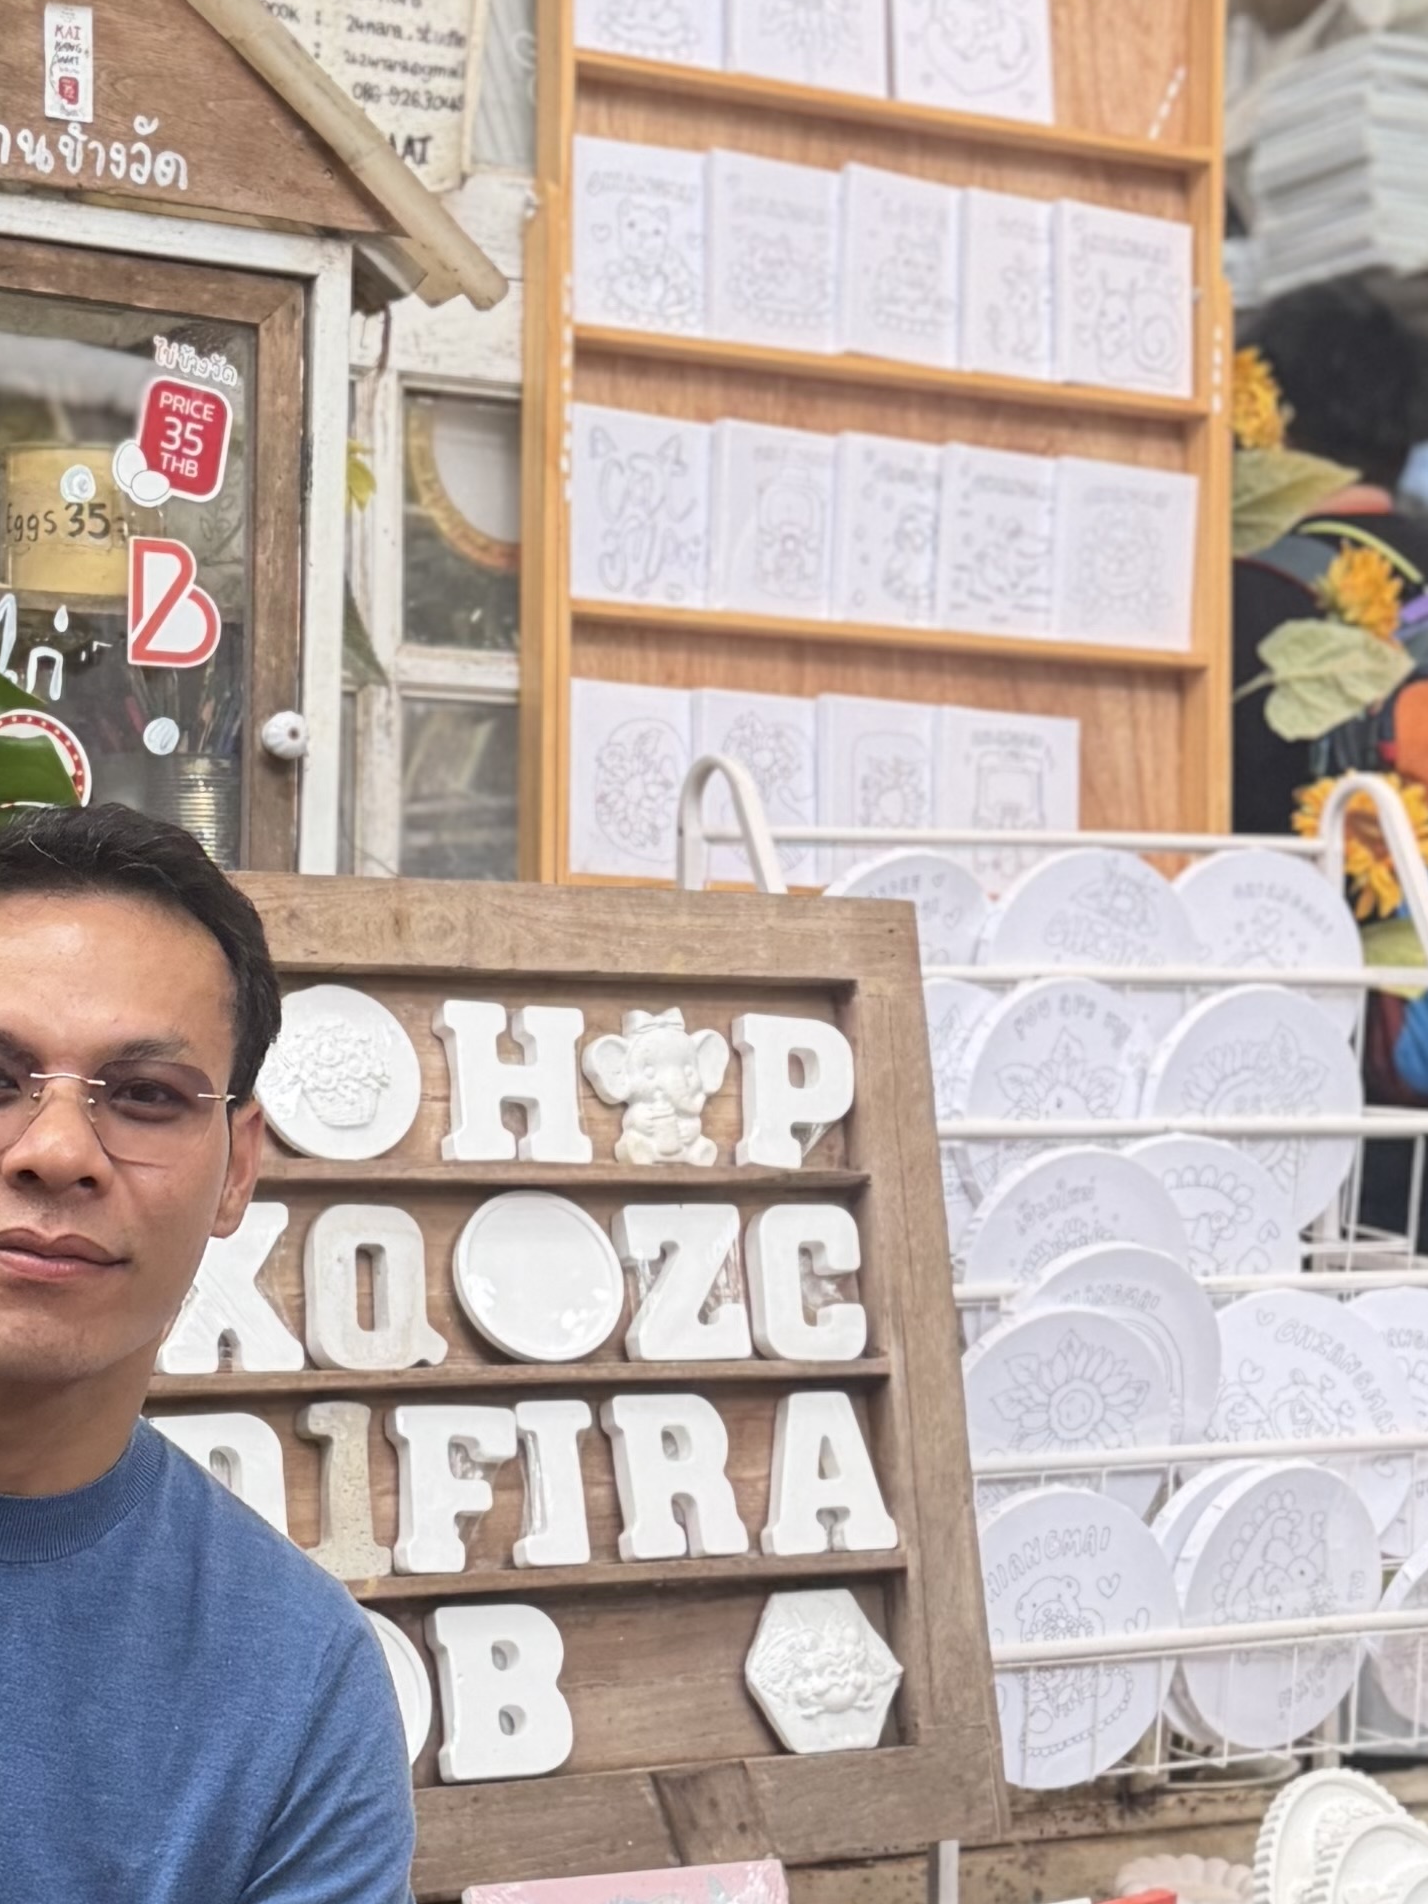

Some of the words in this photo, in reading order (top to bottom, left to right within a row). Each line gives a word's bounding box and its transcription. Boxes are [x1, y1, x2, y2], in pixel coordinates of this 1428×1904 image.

[159, 391, 215, 422] PRICE
[160, 416, 204, 457] 35
[160, 452, 198, 478] THB
[432, 999, 593, 1163] H
[732, 1013, 854, 1169] P
[303, 1204, 449, 1371] Q
[611, 1203, 753, 1361] Z
[745, 1203, 868, 1362] C
[385, 1404, 518, 1576] F
[599, 1393, 750, 1562] R
[761, 1390, 899, 1557] A
[424, 1603, 574, 1783] B
